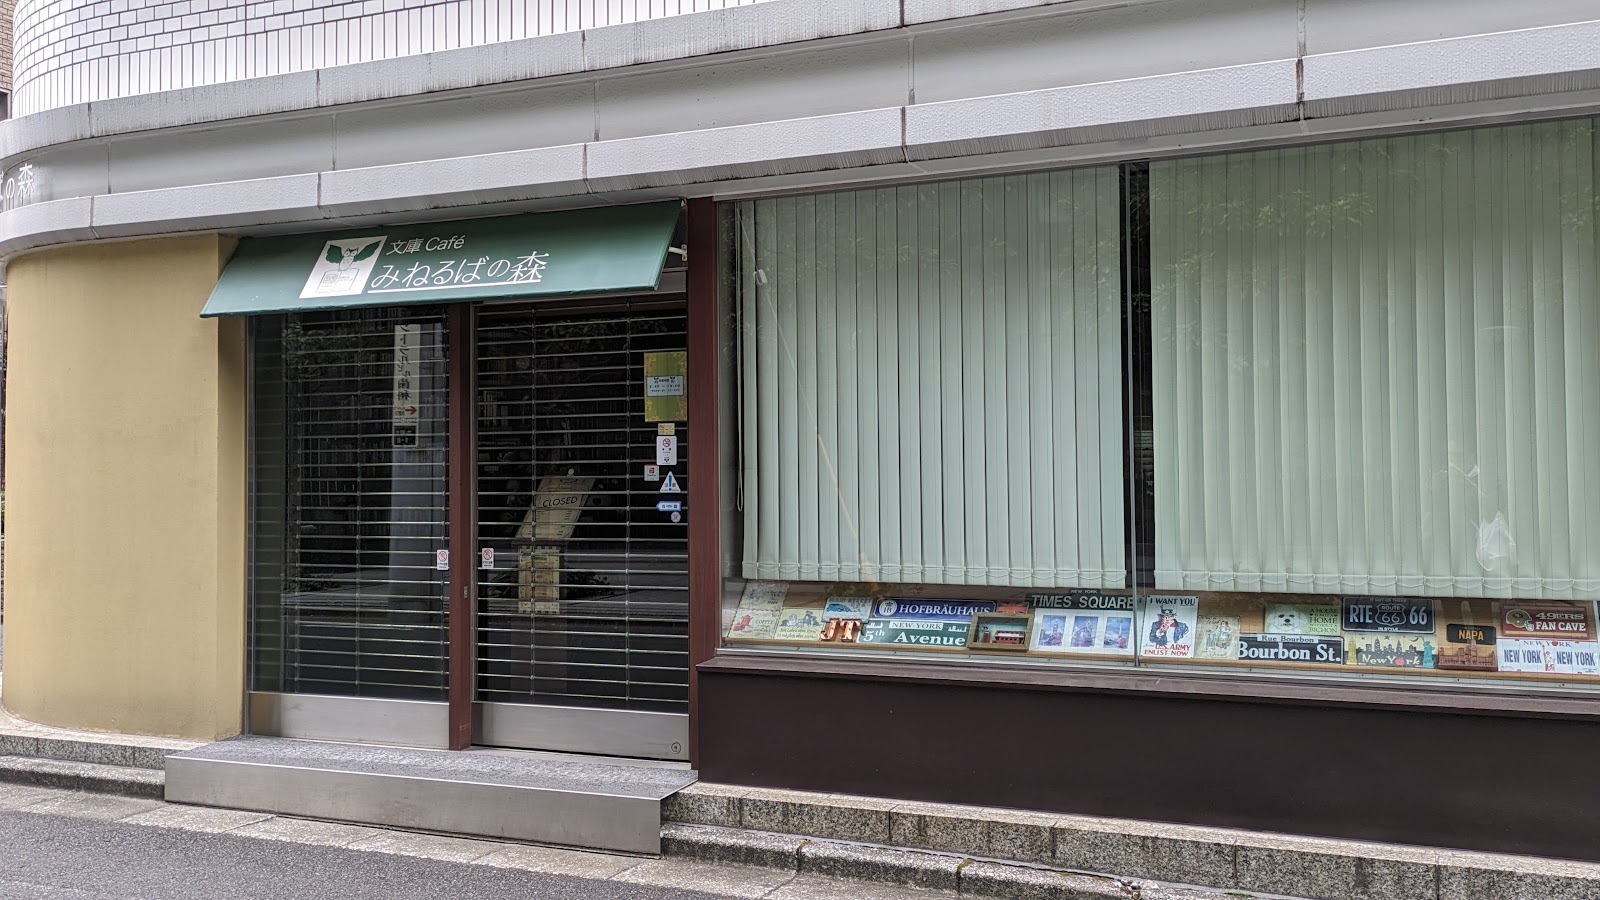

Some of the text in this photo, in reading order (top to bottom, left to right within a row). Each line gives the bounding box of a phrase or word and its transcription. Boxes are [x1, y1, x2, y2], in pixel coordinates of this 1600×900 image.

[0, 163, 34, 199] の森
[386, 235, 466, 256] 文庫 Café
[371, 251, 550, 289] みねるばの森
[542, 496, 578, 508] CLOSED
[1031, 595, 1134, 609] TIMES SQUARE
[899, 604, 991, 616] HOFBRÄUHAUS
[1349, 604, 1373, 624] RTE
[1409, 606, 1428, 625] 66
[1535, 612, 1585, 620] 49ERS
[1309, 616, 1338, 624] HOME
[1381, 612, 1400, 624] 66
[916, 622, 943, 630] YORK
[1535, 621, 1587, 631] FAN CAVE
[863, 629, 966, 646] 5th Avenue
[1280, 635, 1314, 643] Bourbon
[1458, 629, 1484, 641] NAPA
[1169, 644, 1192, 652] ARMY
[1239, 641, 1311, 660] Bourbon
[1316, 643, 1341, 662] St.
[1503, 649, 1596, 667] NEW YORK NEW YORK
